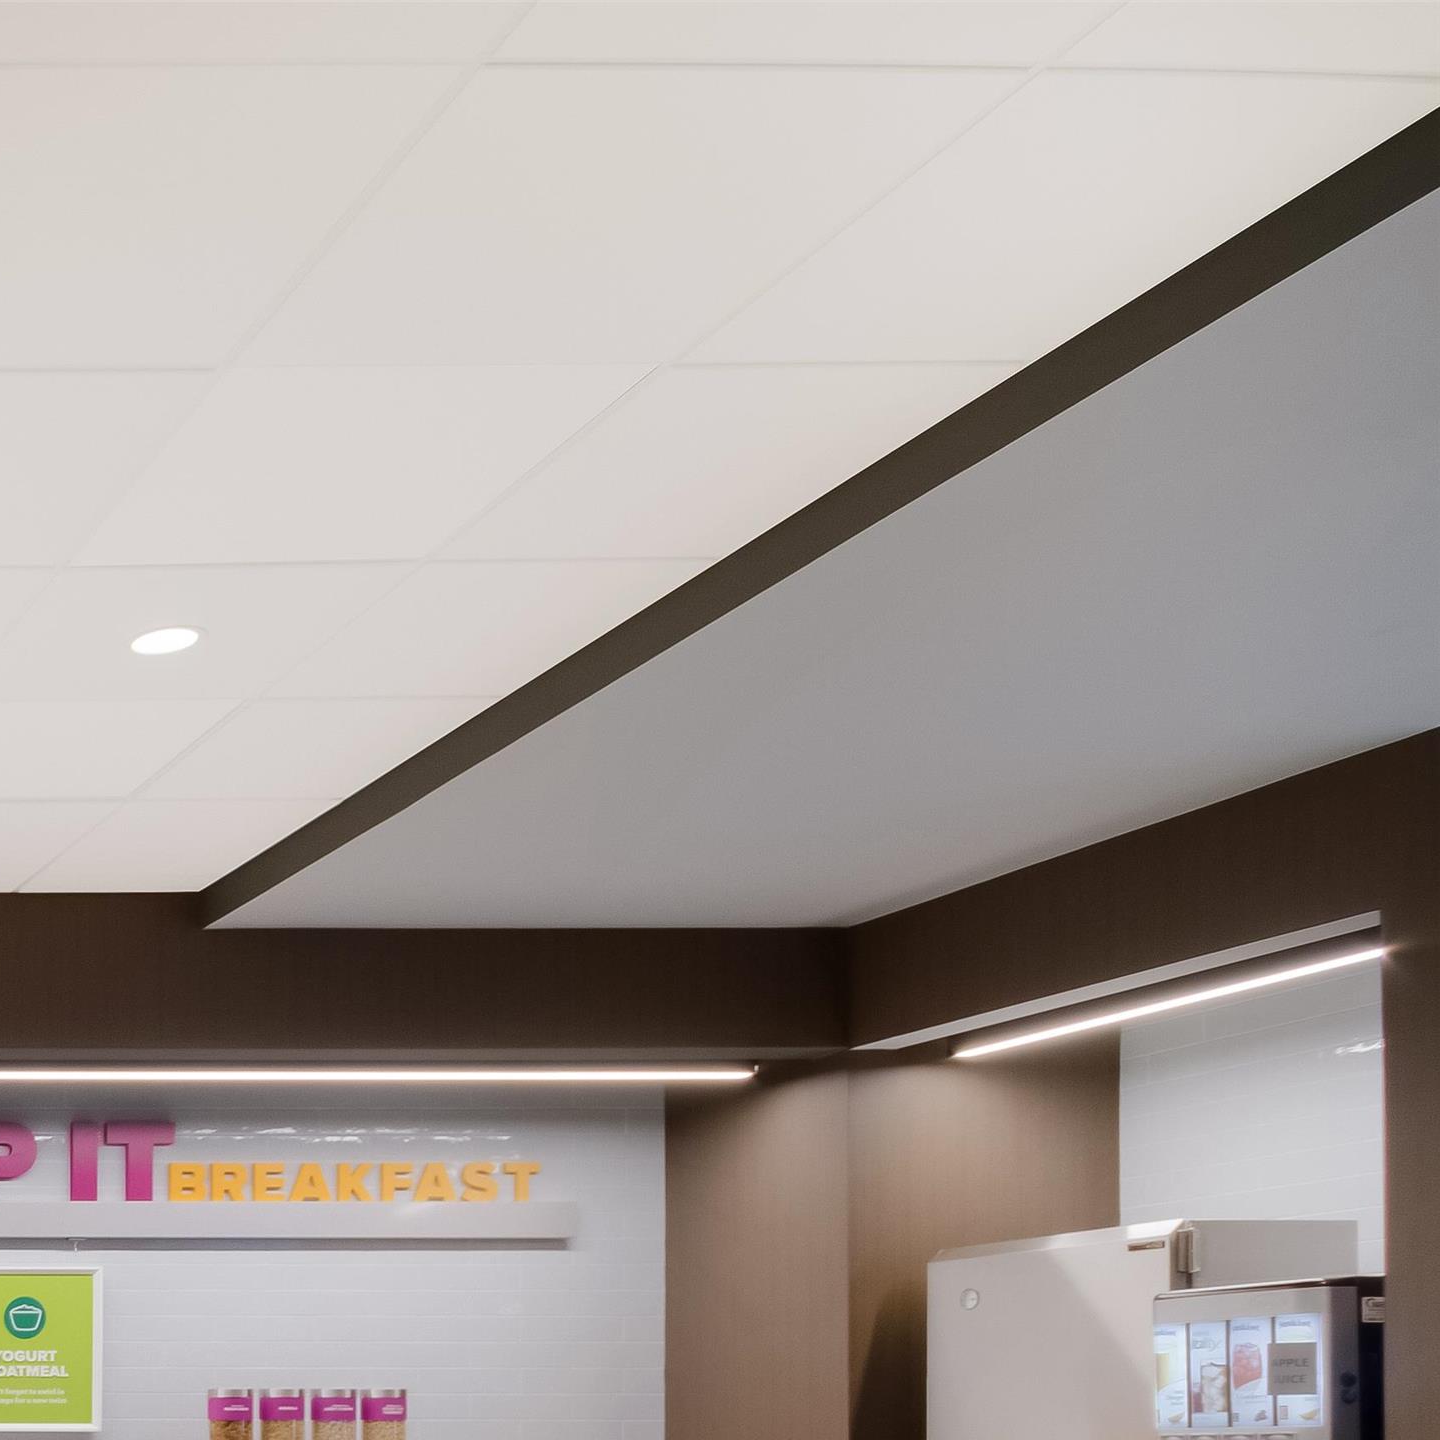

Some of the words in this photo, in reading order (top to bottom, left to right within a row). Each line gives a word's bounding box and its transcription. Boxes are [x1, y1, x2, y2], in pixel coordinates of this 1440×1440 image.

[70, 1121, 175, 1202] IT
[169, 1162, 544, 1202] BREAKFAST
[1273, 1358, 1310, 1368] APPLE
